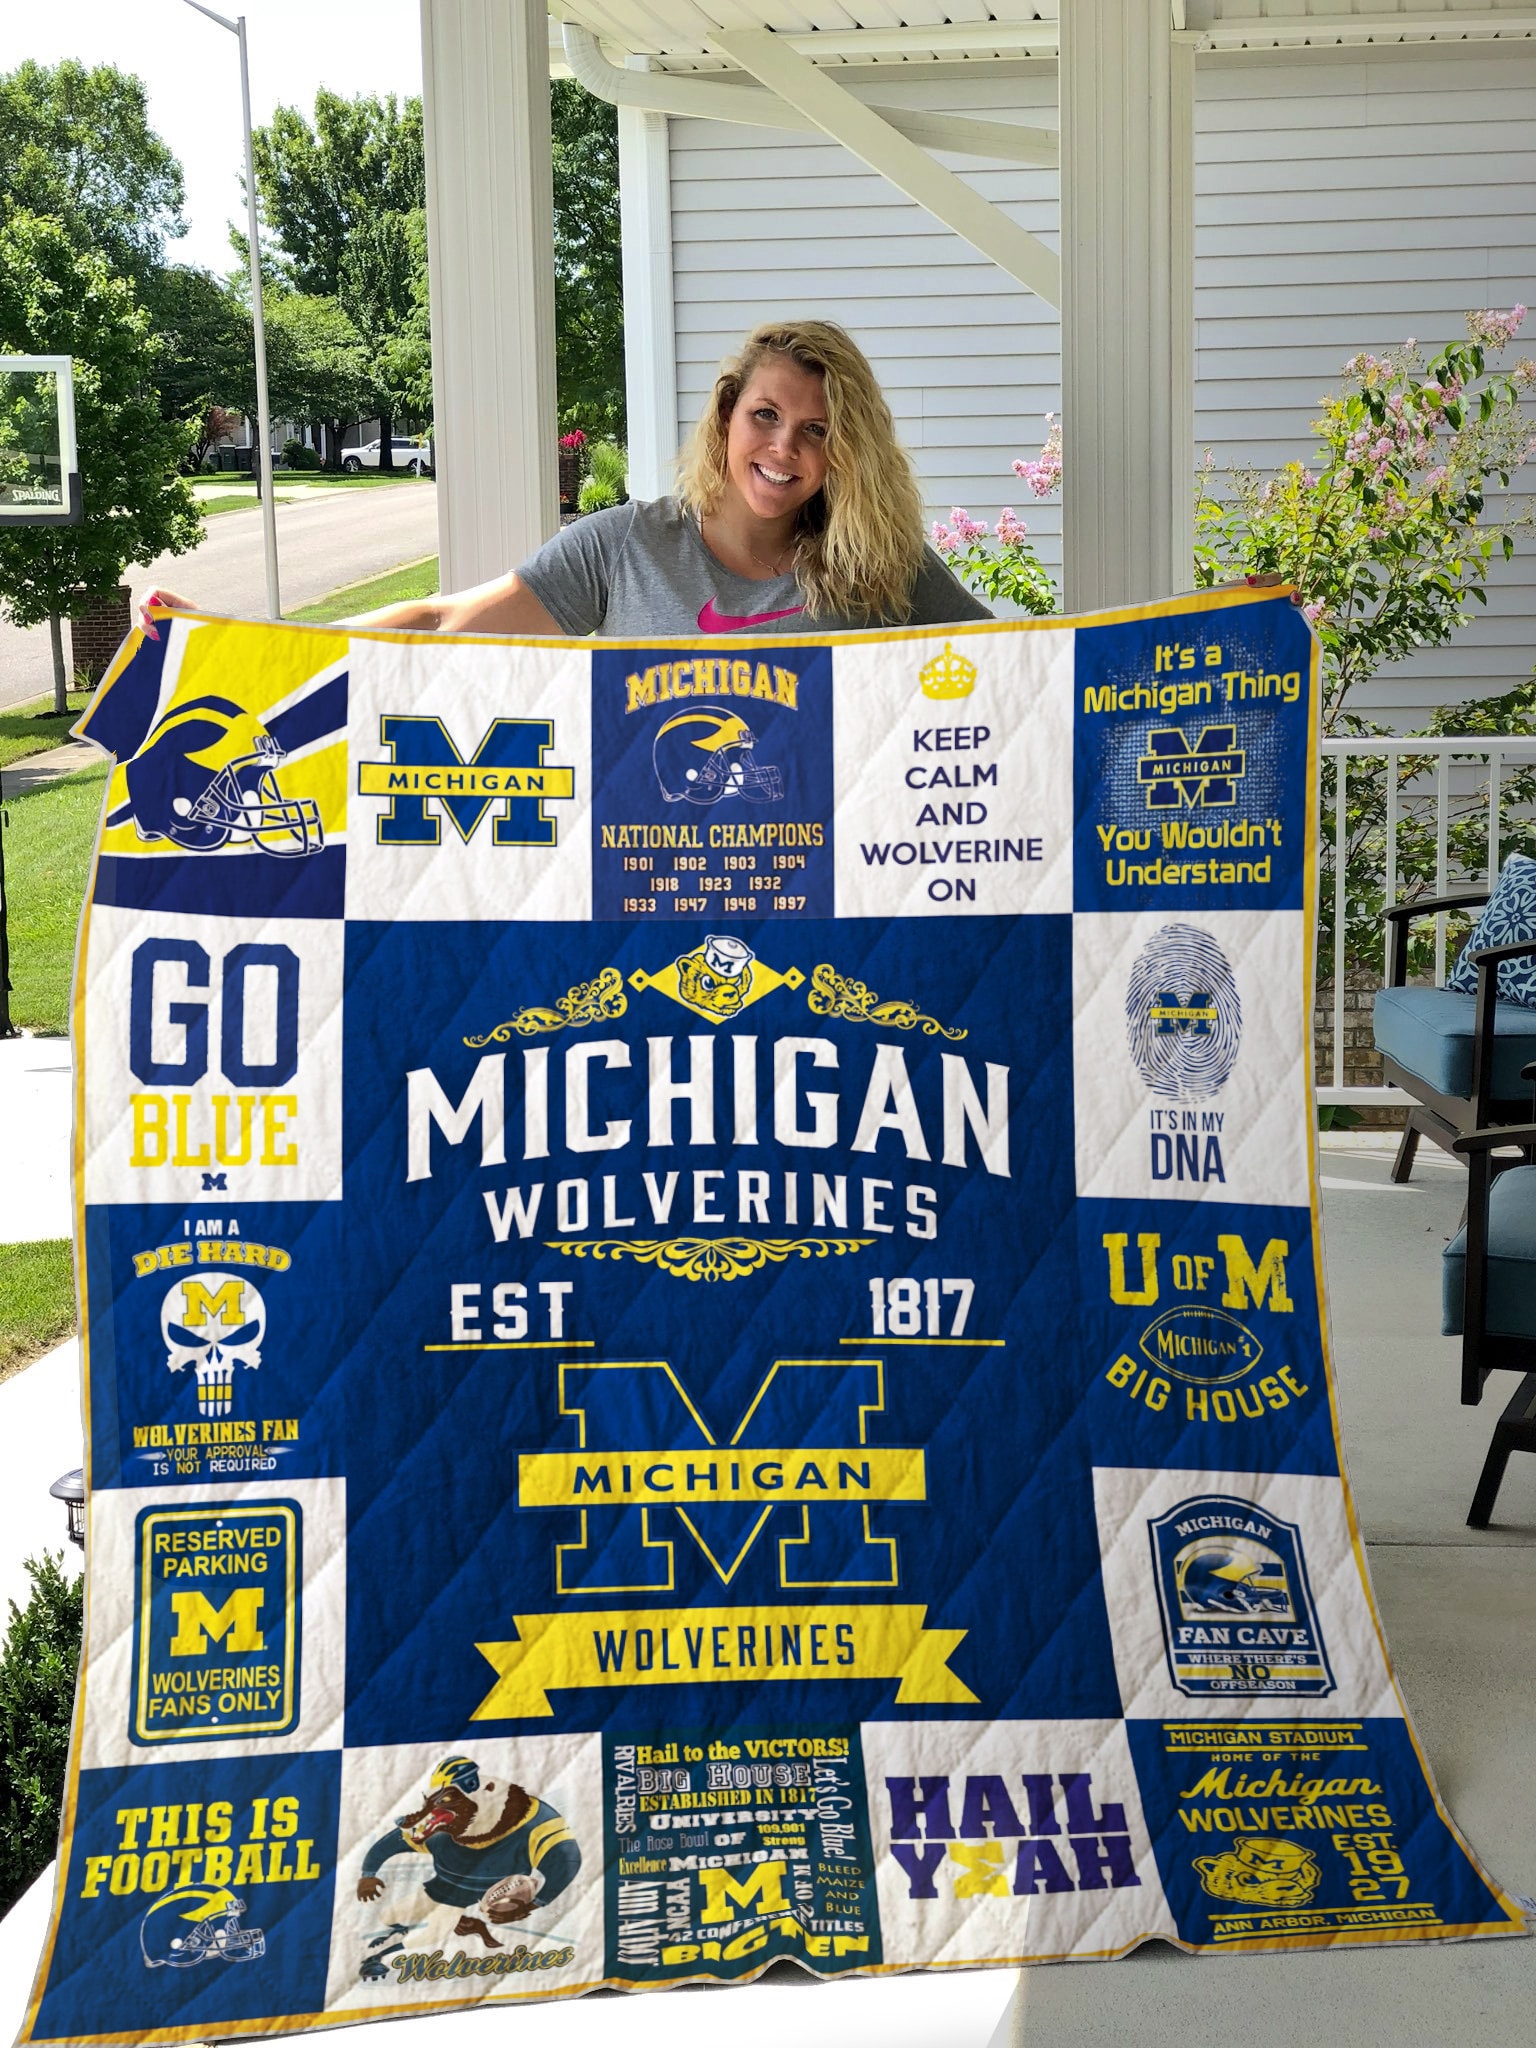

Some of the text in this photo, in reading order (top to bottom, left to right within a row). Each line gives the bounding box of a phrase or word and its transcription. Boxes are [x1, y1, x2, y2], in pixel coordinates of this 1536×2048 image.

[12, 489, 60, 501] SPALDING
[1156, 643, 1222, 672] It's a
[625, 658, 799, 715] MICHIGAN
[1084, 669, 1300, 714] Michigan Thing
[913, 726, 990, 752] KEEP
[905, 764, 997, 789] CALM
[1152, 760, 1232, 775] MICHIGAN
[388, 773, 545, 791] MICHIGAN
[916, 802, 987, 826] AND
[601, 823, 824, 848] NATIONAL CHAMPIONS
[1096, 819, 1282, 851] You Wouldn't
[624, 856, 806, 871] 1901 1902 1903 1904
[860, 838, 1042, 865] WOLVERINE
[1106, 855, 1271, 885] Understand
[650, 876, 781, 892] 1918 1923 1932
[928, 879, 975, 901] ON
[624, 896, 806, 912] 1933 1947 1948 1997
[130, 938, 300, 1087] GO
[405, 1034, 1010, 1183] MICHIGAN
[1150, 1110, 1224, 1132] IT'S IN MY
[130, 1094, 298, 1167] BLUE
[1152, 1134, 1226, 1183] DNA
[202, 1173, 227, 1190] M
[482, 1170, 938, 1243] WOLVERINES
[184, 1219, 240, 1236] I AM A
[134, 1240, 291, 1277] DIE HARD
[1102, 1233, 1294, 1312] U OF M
[182, 1280, 245, 1326] M
[450, 1277, 975, 1342] EST 1817
[1105, 1354, 1308, 1422] BIG HOUSE
[133, 1419, 299, 1448] WOLVERINES FAN
[153, 1457, 277, 1475] IS NOT REQUIRED
[167, 1446, 267, 1460] YOUR APPROVAL
[573, 1461, 871, 1494] MICHIGAN
[155, 1527, 280, 1553] RESERVED
[1174, 1516, 1272, 1539] MICHIGAN
[164, 1552, 268, 1578] PARKING
[170, 1587, 264, 1656] M
[594, 1624, 854, 1673] WOLVERINES
[1177, 1627, 1309, 1645] FAN CAVE
[1188, 1654, 1307, 1664] WHERE THERE'S
[1228, 1664, 1270, 1680] NO
[152, 1665, 280, 1694] WOLVERINES
[1210, 1680, 1296, 1690] OFFSEASON
[148, 1690, 282, 1718] FANS ONLY
[1170, 1731, 1354, 1744] MICHIGAN STADIUM
[636, 1738, 850, 1764] Hail to the VICTORS!
[1211, 1754, 1254, 1762] HOME
[1291, 1753, 1320, 1761] THE
[636, 1762, 811, 1794] BIG HOUSE
[812, 1758, 850, 1793] Let's
[1180, 1767, 1380, 1806] Michigan
[614, 1745, 636, 1834] RIVALRIES
[640, 1788, 816, 1812] ESTABLISHED IN 1817
[649, 1808, 820, 1830] UNIVERSITY
[816, 1796, 852, 1820] Go
[885, 1773, 1128, 1839] HAIL
[1178, 1804, 1392, 1832] WOLVERINES
[116, 1796, 299, 1850] THIS IS
[618, 1838, 640, 1853] The
[714, 1832, 746, 1846] OF
[763, 1836, 806, 1846] Strong
[1332, 1834, 1398, 1851] EST.
[80, 1839, 320, 1898] FOOTBALL
[619, 1856, 666, 1875] Excellence
[669, 1848, 808, 1872] MICHIGAN
[818, 1863, 861, 1875] BLEED
[1343, 1850, 1404, 1876] 19
[698, 1861, 792, 1924] M
[816, 1876, 866, 1888] MAIZE
[826, 1890, 859, 1900] AND
[1348, 1876, 1410, 1901] 27
[666, 1878, 690, 1930] NCAA
[826, 1902, 860, 1915] BLUE
[669, 1930, 693, 1942] 42
[810, 1920, 864, 1932] TITLES
[1214, 1920, 1254, 1934] ANN
[1336, 1909, 1436, 1924] MICHIGAN
[662, 1917, 869, 1965] BIG TEN
[392, 1946, 574, 1984] Wolverines
